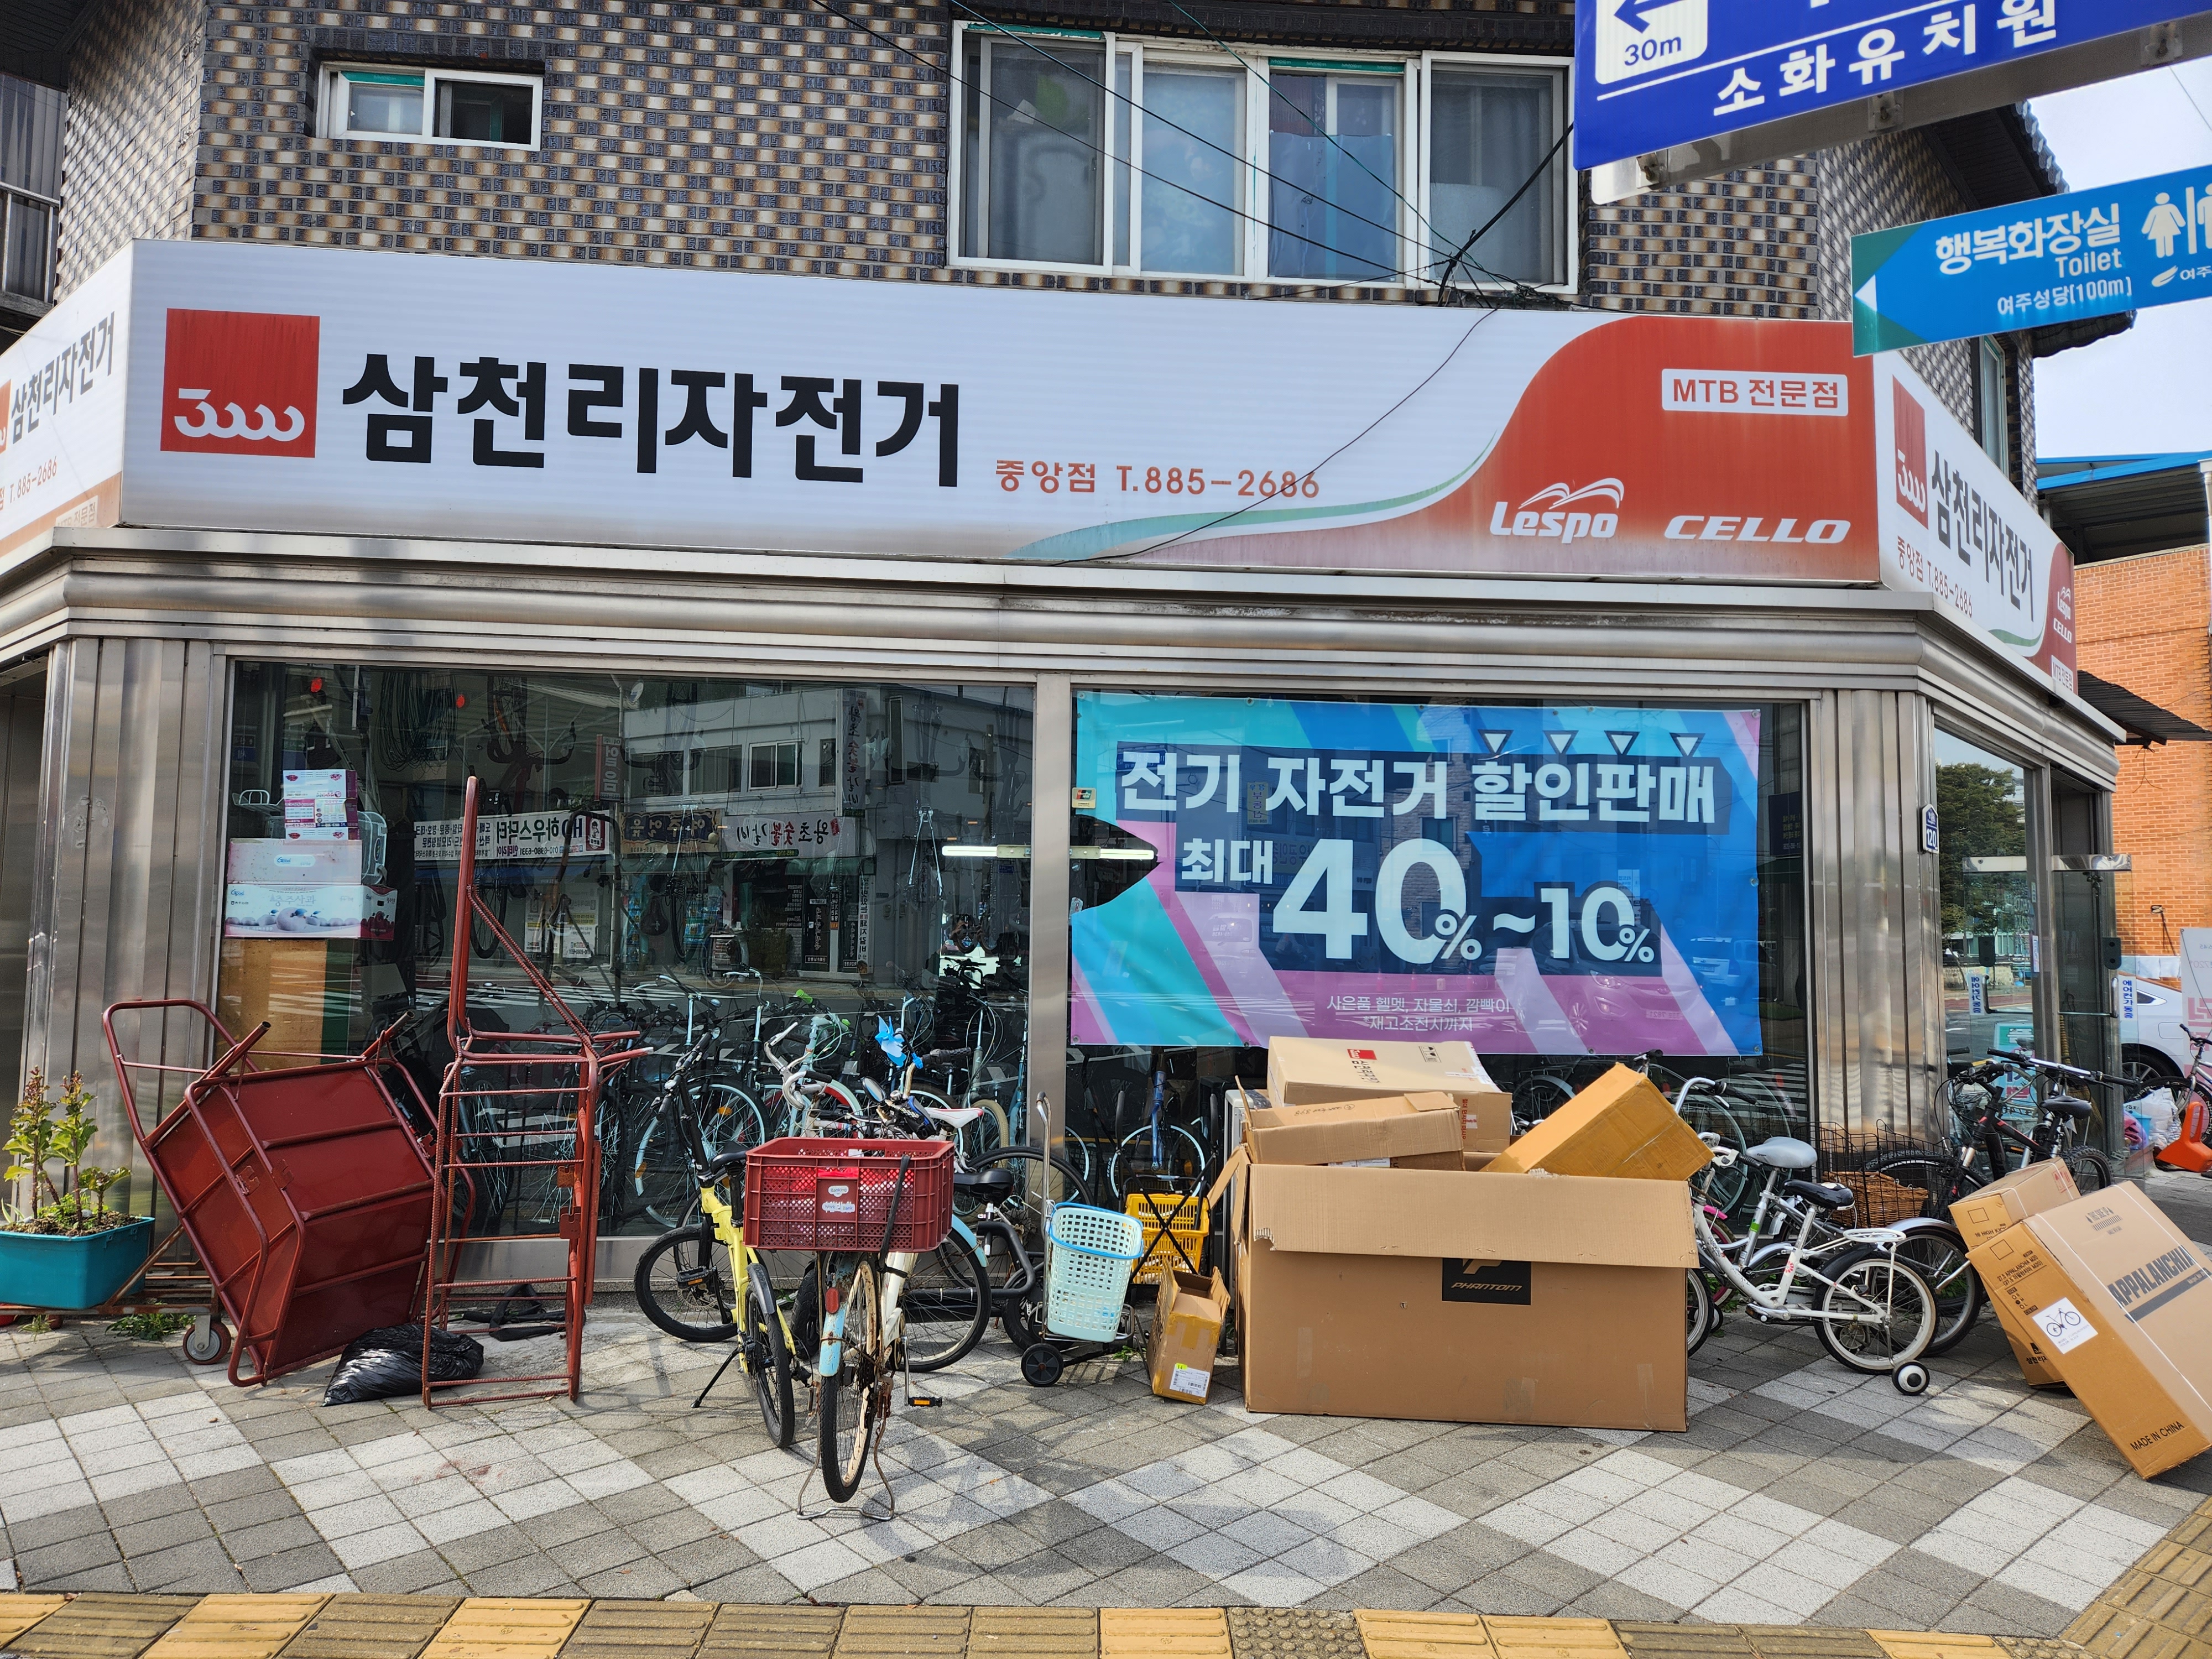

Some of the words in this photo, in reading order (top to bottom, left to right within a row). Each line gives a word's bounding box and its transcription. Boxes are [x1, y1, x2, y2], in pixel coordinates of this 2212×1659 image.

[1624, 34, 1682, 66] 30m
[1713, 0, 2057, 116] 소화유치원
[1936, 202, 2121, 275] 행복화장실
[2055, 248, 2122, 278] Toilet
[12, 311, 115, 445] 삼천리자전거
[1673, 379, 1739, 404] MTB
[1749, 379, 1838, 408] 전문점
[343, 354, 958, 487] 삼천리자전거
[996, 460, 1095, 493] 중앙점
[1117, 465, 1320, 498] T.885-2686
[1490, 501, 1619, 544] Lespo
[1664, 515, 1851, 544] CELLO
[1932, 450, 2034, 623] 삼천리자전거
[1897, 535, 1923, 583] 중앙점
[2053, 618, 2072, 644] CELLO
[1123, 754, 1240, 812] 전기
[1265, 757, 1447, 819] 자전거
[1472, 763, 1715, 823] 할인판매
[1926, 828, 1937, 847] 120
[1182, 837, 1274, 883] 최대
[1327, 996, 1371, 1011] 사은품
[1414, 998, 1461, 1014] 자물쇠,
[1467, 998, 1510, 1013] 깜빡이
[1451, 1281, 1523, 1293] PHANTOM
[2107, 1244, 2198, 1309] APPALANCHIA
[2130, 1435, 2153, 1451] MADE
[2150, 1431, 2161, 1441] IN
[2159, 1421, 2185, 1436] CHINA
